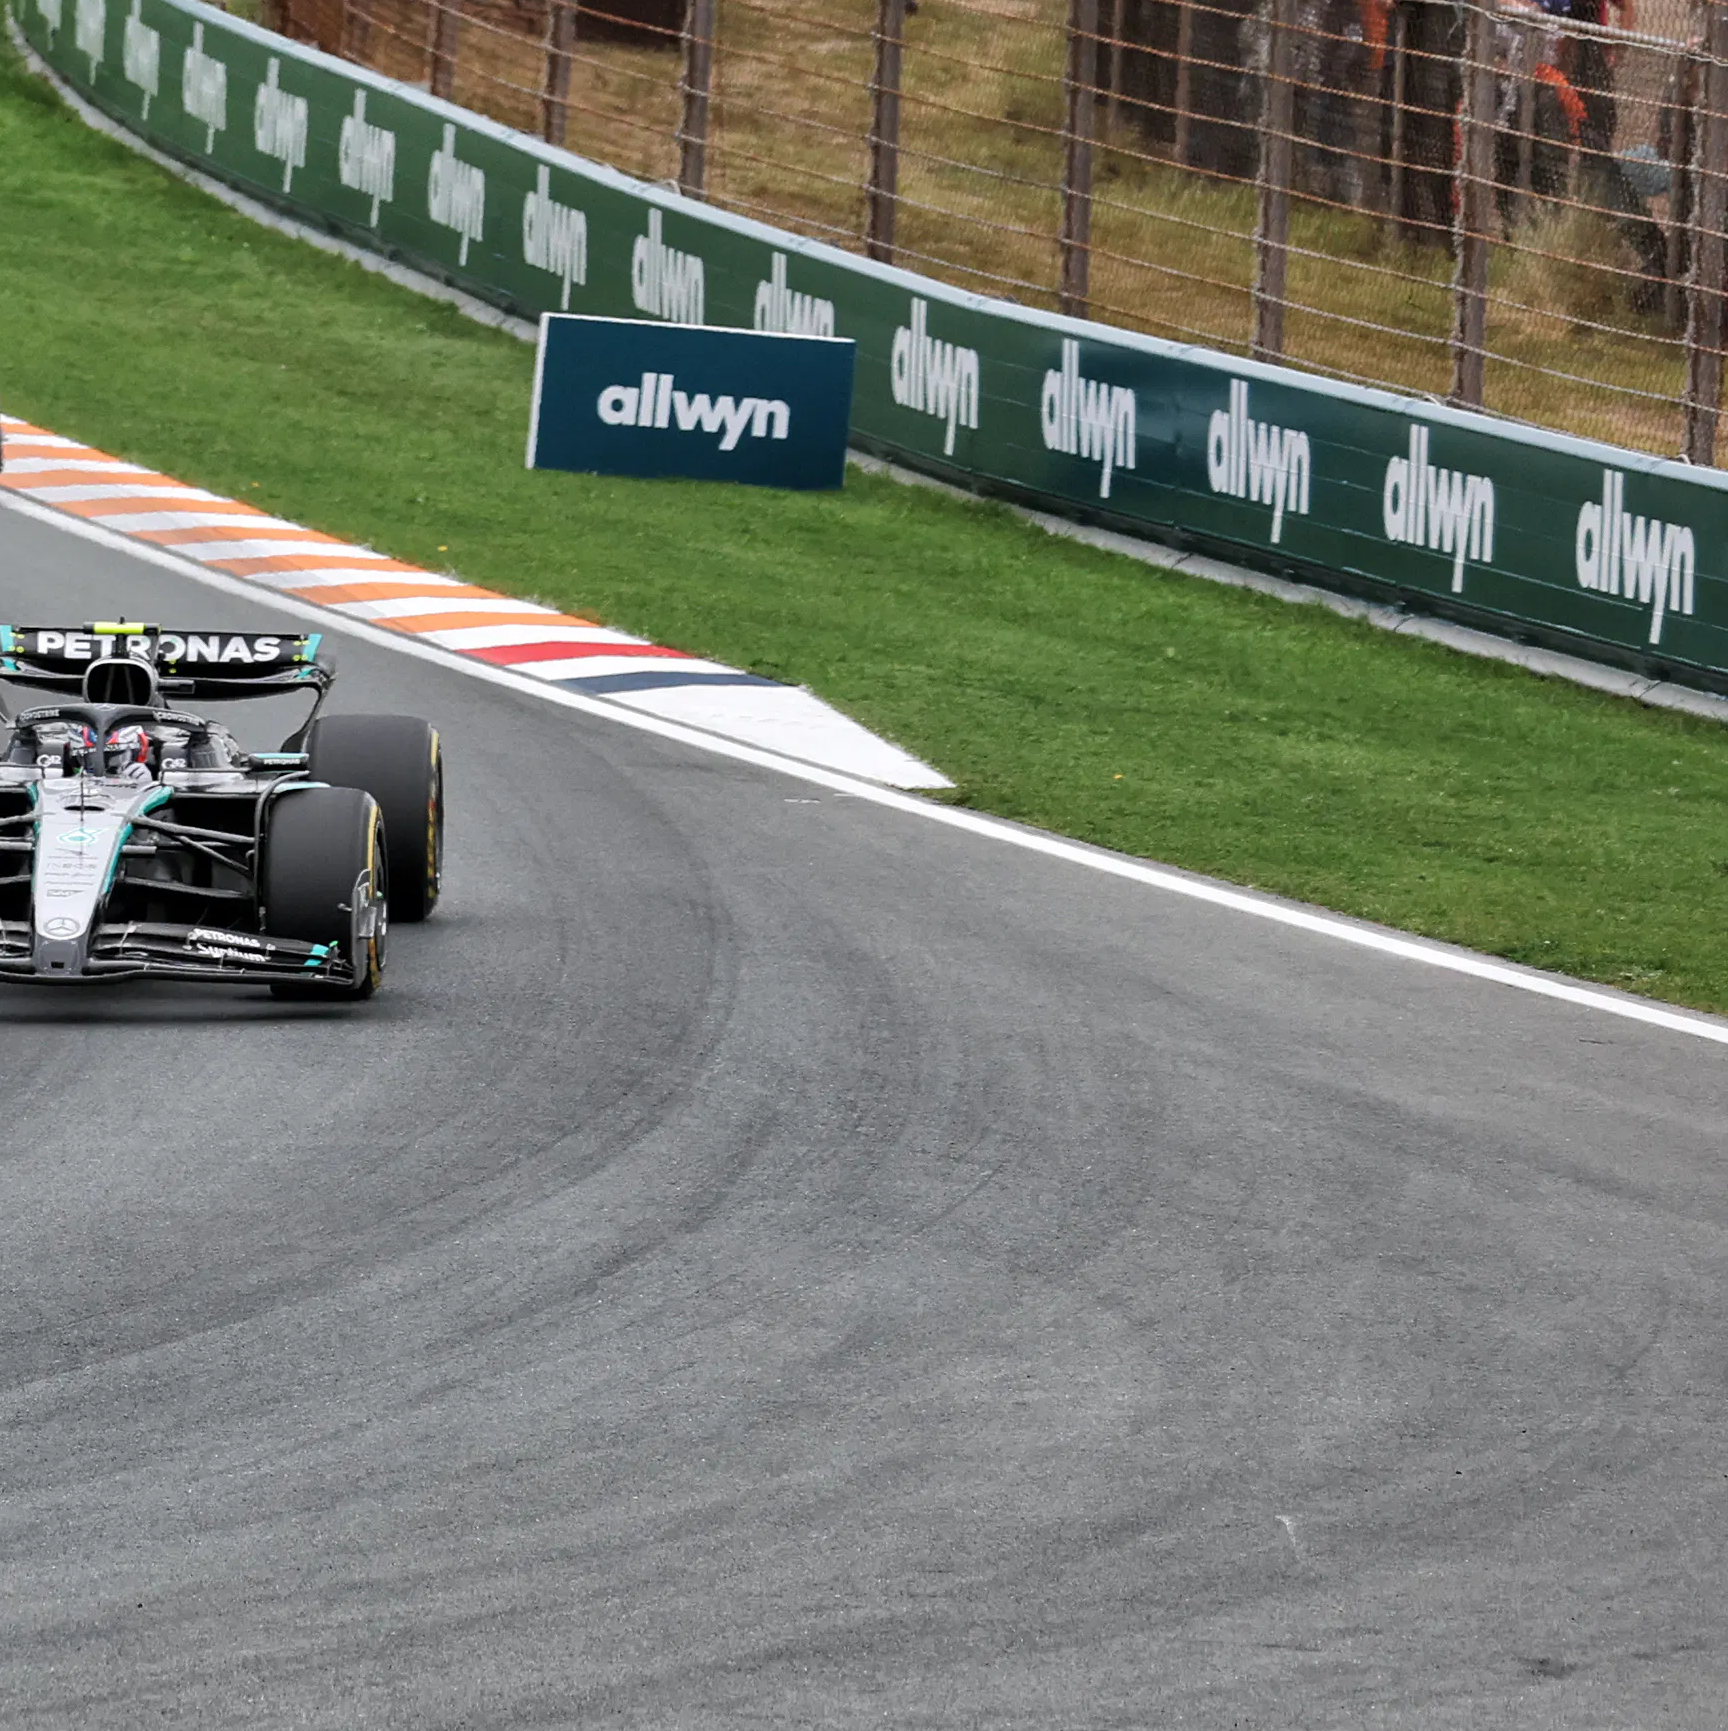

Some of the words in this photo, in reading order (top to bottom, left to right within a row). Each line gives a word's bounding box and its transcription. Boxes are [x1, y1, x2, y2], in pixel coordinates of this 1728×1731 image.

[597, 372, 791, 451] allwyn
[892, 298, 979, 454] allwyn
[1042, 340, 1136, 497] allwyn
[1207, 379, 1309, 542] allwyn
[1384, 424, 1494, 593] allwyn
[1576, 469, 1697, 643] allwyn
[36, 631, 281, 663] PETRONAS
[191, 928, 262, 949] PETRONAS
